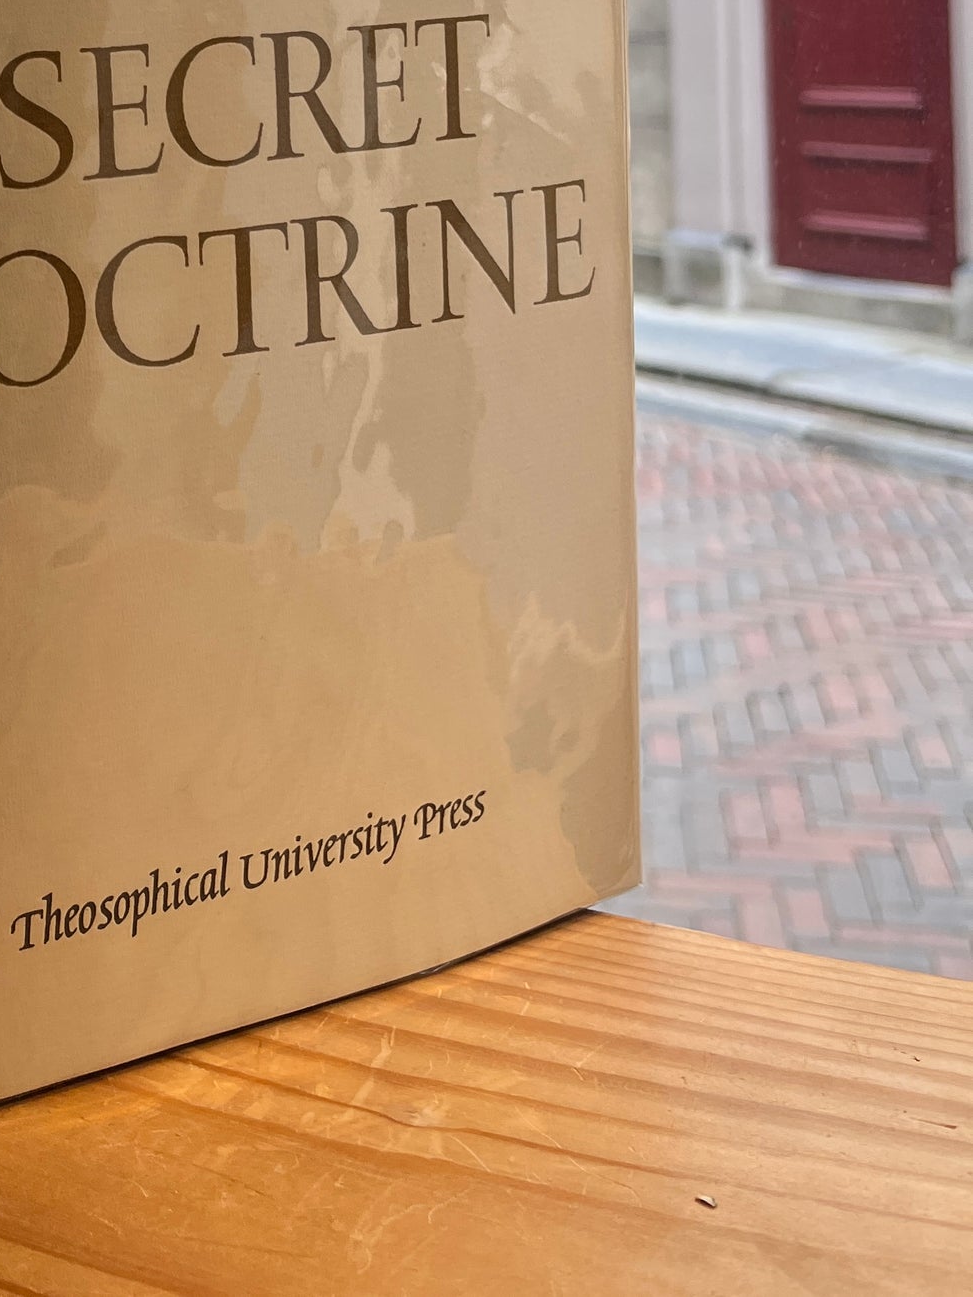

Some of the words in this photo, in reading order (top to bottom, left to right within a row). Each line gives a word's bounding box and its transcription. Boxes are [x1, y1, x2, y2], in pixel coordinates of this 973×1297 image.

[10, 850, 231, 952] Theosophical
[240, 812, 406, 890] University
[414, 789, 487, 841] Press
